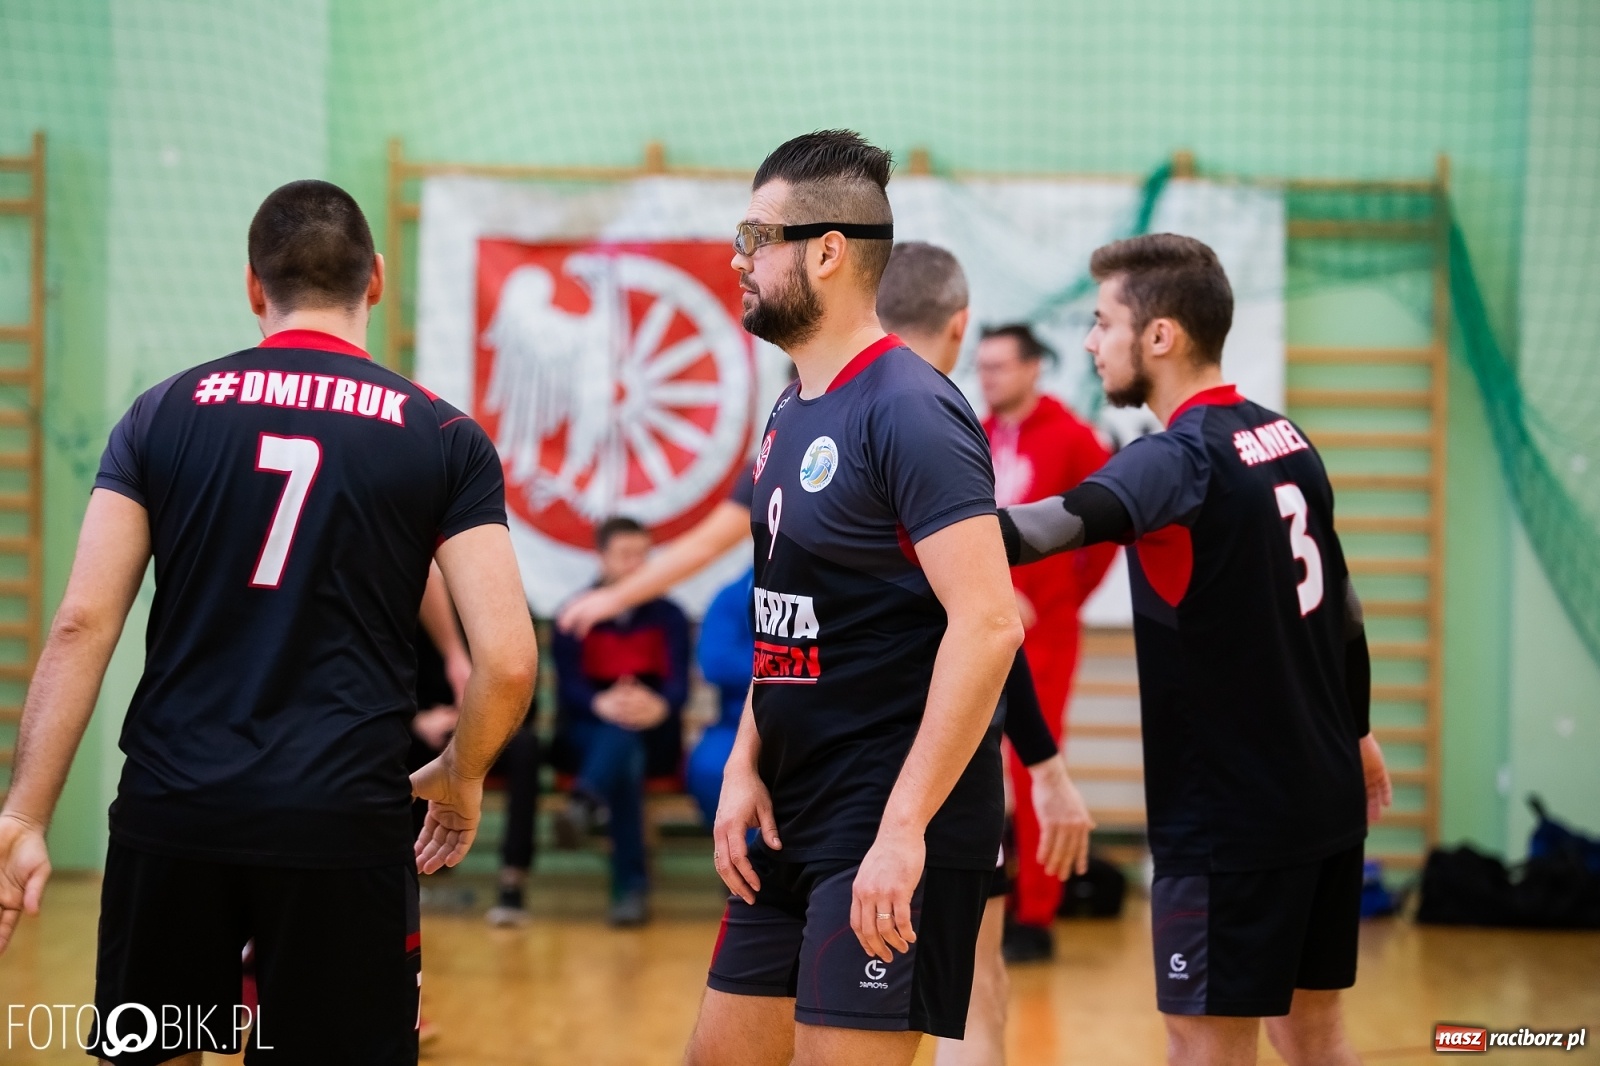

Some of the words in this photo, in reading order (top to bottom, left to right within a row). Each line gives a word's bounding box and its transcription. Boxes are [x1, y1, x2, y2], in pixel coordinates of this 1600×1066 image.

[248, 432, 323, 589] 7
[768, 487, 783, 561] 9
[1273, 482, 1324, 617] 3
